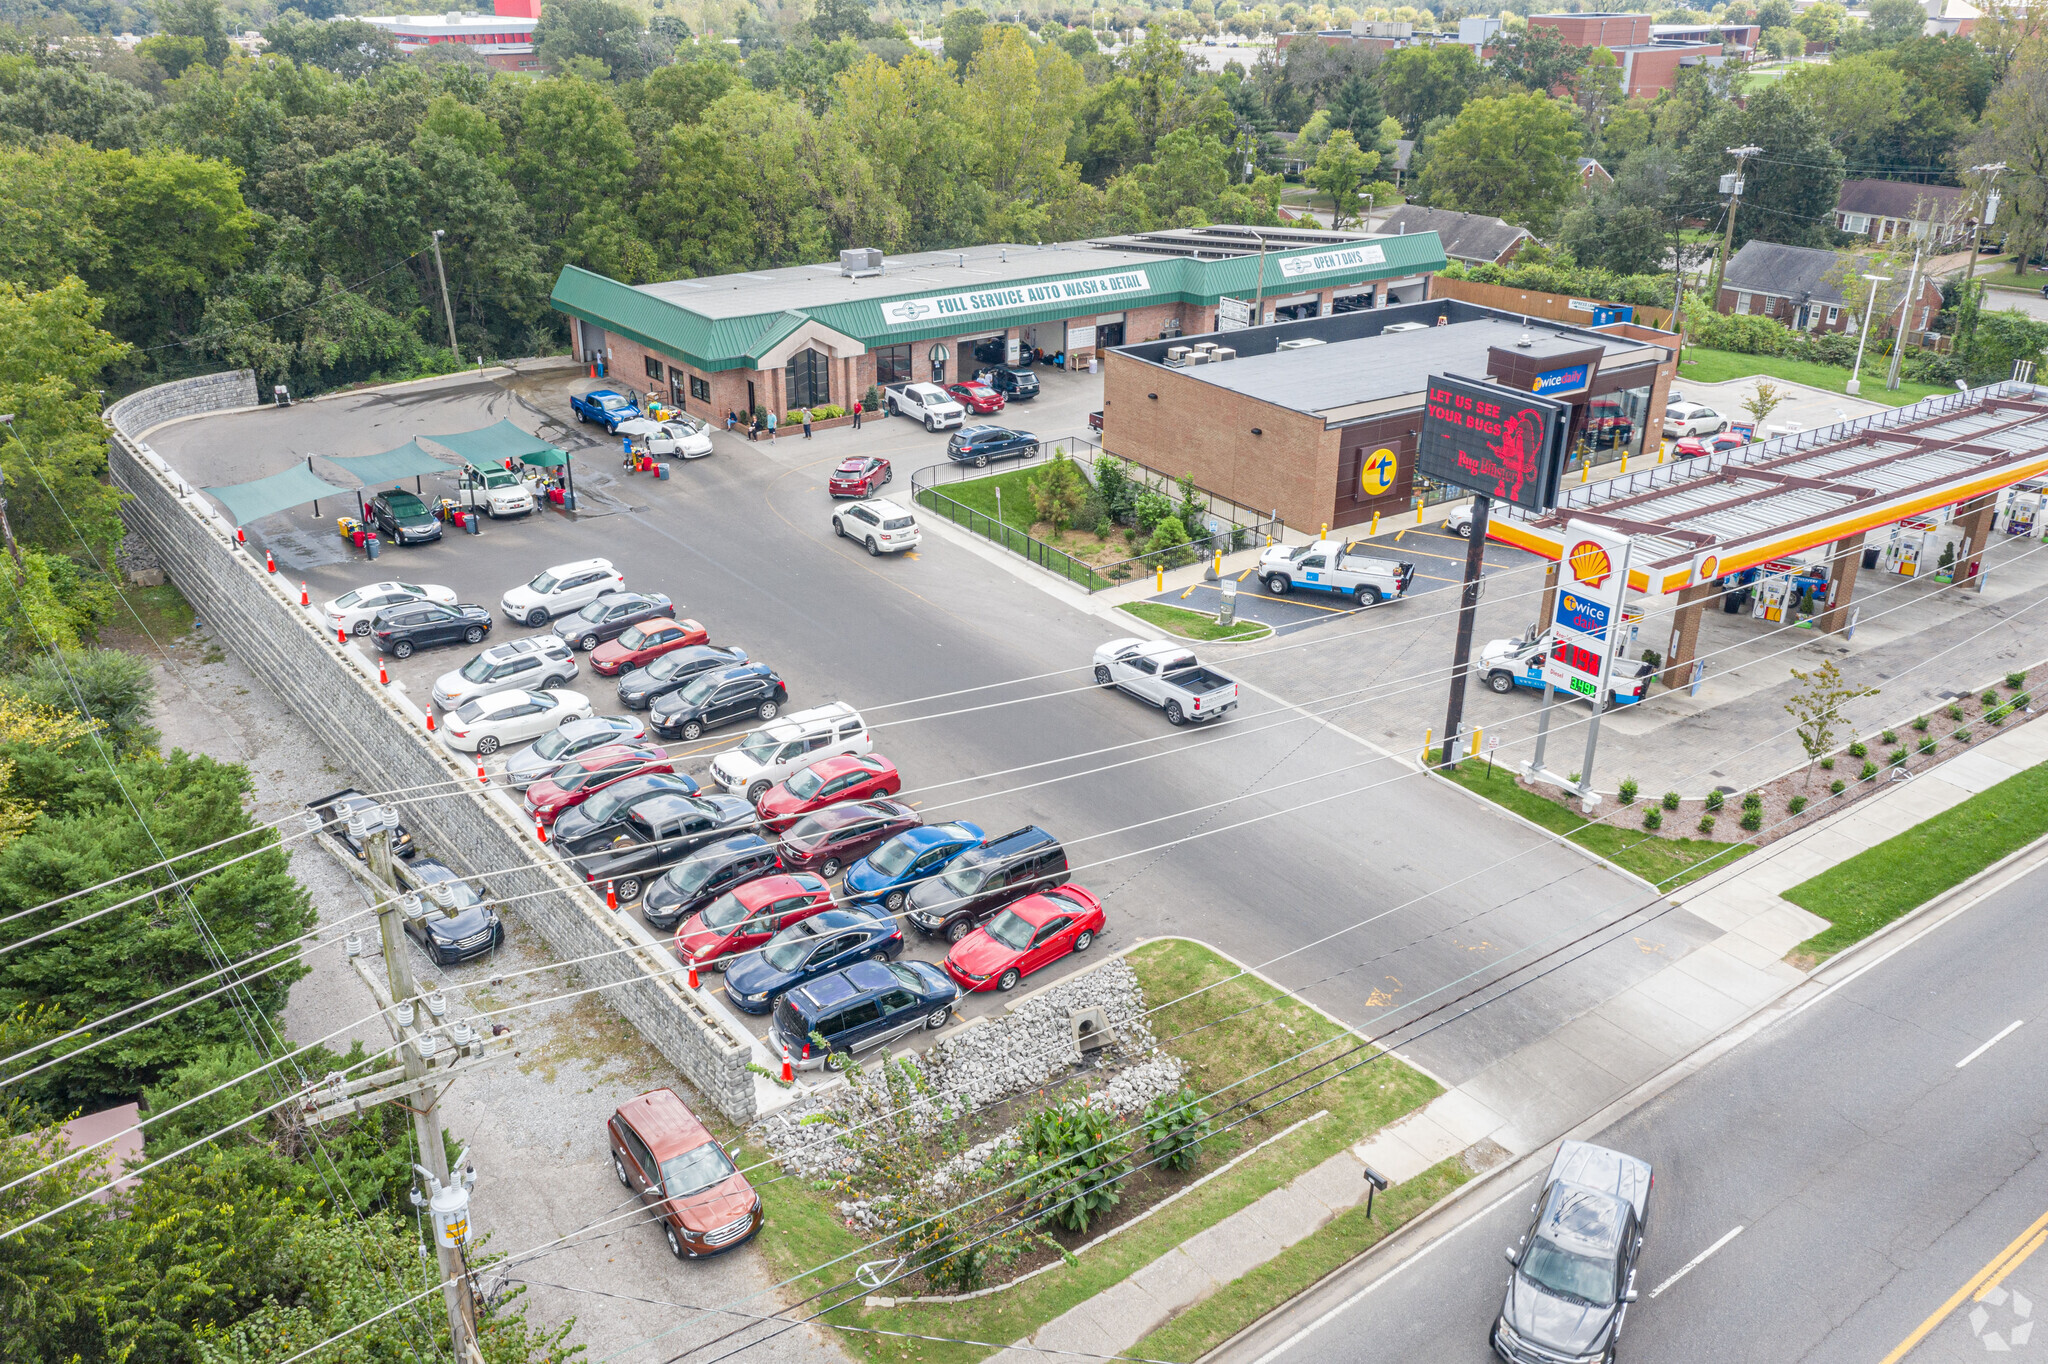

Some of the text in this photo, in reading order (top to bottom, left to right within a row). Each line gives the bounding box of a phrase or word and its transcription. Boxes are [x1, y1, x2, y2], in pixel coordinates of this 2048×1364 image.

[1314, 254, 1336, 269] OPEN
[1335, 254, 1341, 266] 7
[1341, 250, 1363, 264] DAYS
[936, 297, 968, 314] FULL
[970, 289, 1025, 310] SERVICE
[1028, 284, 1060, 303] AUTO
[1063, 279, 1099, 296] WASH
[1100, 280, 1108, 291] &
[1110, 274, 1142, 290] DETAIL
[1430, 388, 1500, 418] LET US SEE
[1428, 404, 1502, 436] YOUR BUGS
[1457, 450, 1518, 482] Bug Blaster
[1566, 597, 1604, 620] twice
[1574, 614, 1602, 634] daily
[1556, 631, 1572, 641] Regar
[1550, 668, 1564, 678] Diesel
